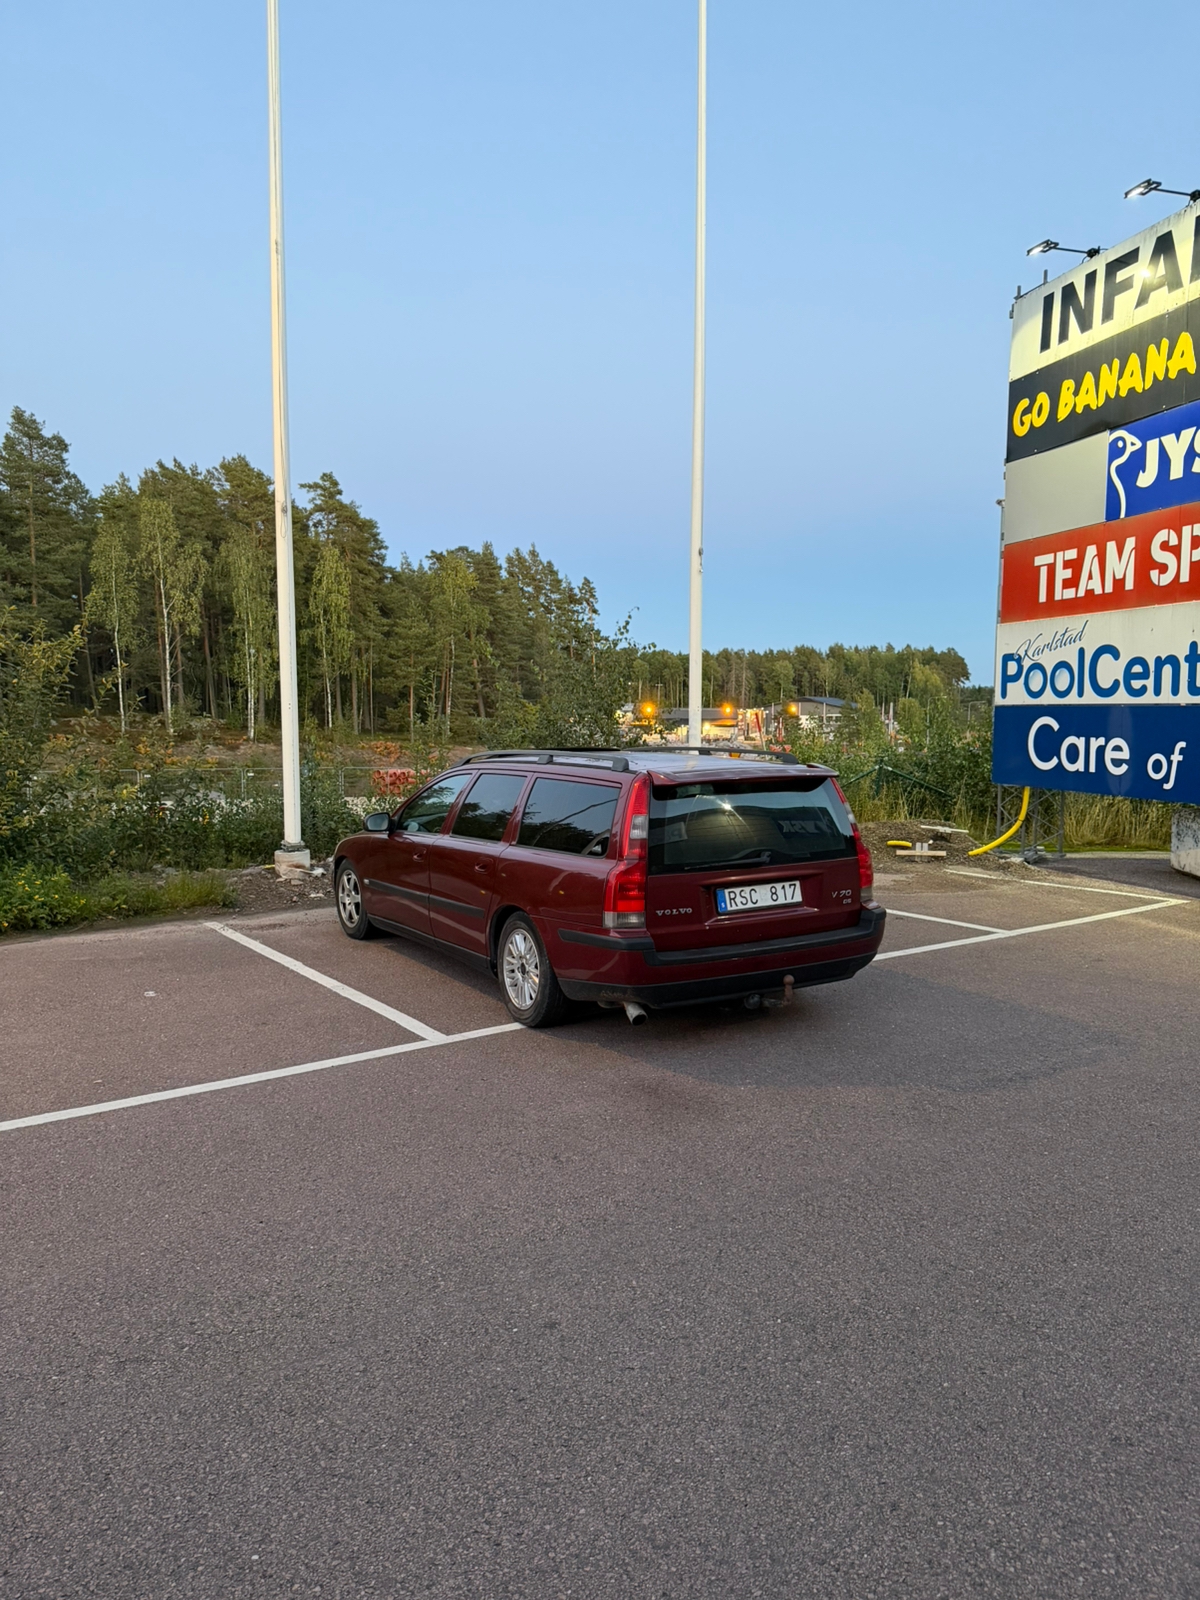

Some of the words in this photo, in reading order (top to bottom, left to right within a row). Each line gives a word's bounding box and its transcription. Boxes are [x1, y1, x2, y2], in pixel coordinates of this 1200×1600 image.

[1040, 214, 1200, 354] INFA
[1012, 391, 1050, 437] GO
[1057, 331, 1196, 422] BANANA
[1034, 536, 1136, 603] TEAM
[1013, 619, 1089, 665] Karlstad
[1028, 716, 1130, 776] Care
[1147, 741, 1187, 790] of
[655, 907, 693, 916] VOLVO
[728, 888, 758, 908] RSC
[769, 883, 797, 902] 817
